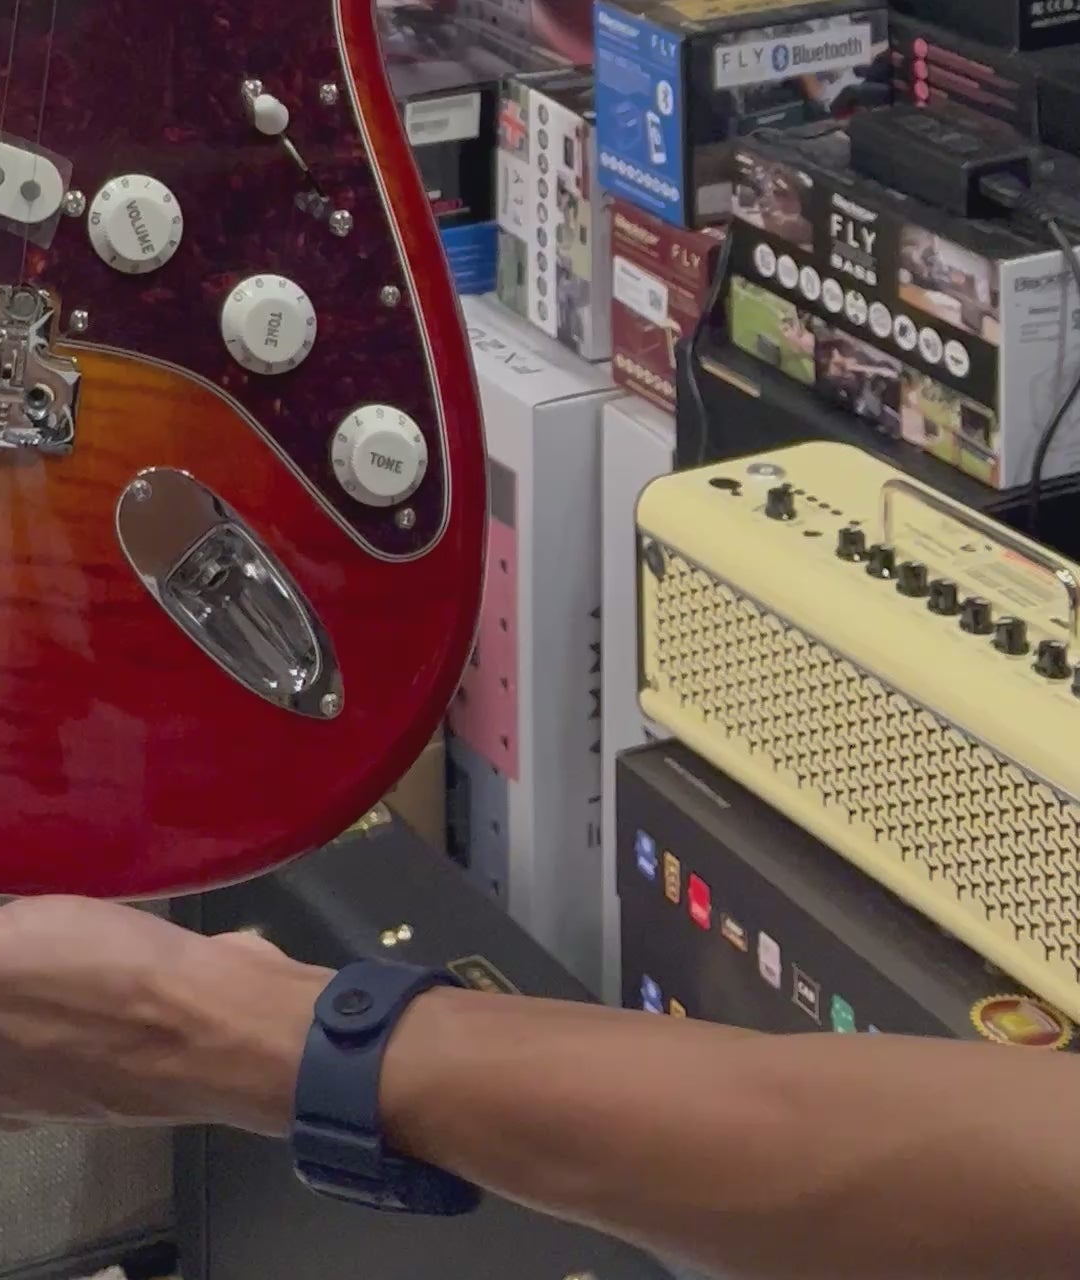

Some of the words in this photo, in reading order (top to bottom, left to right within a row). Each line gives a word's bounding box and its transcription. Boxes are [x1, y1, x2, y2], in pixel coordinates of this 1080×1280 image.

[651, 33, 676, 59] FLY
[721, 47, 765, 71] FLY
[792, 37, 863, 66] Bluetooth
[126, 200, 156, 255] VOLUME
[830, 213, 877, 255] FLY
[672, 243, 701, 269] FLY
[264, 311, 283, 349] TONE
[370, 451, 404, 475] TONE
